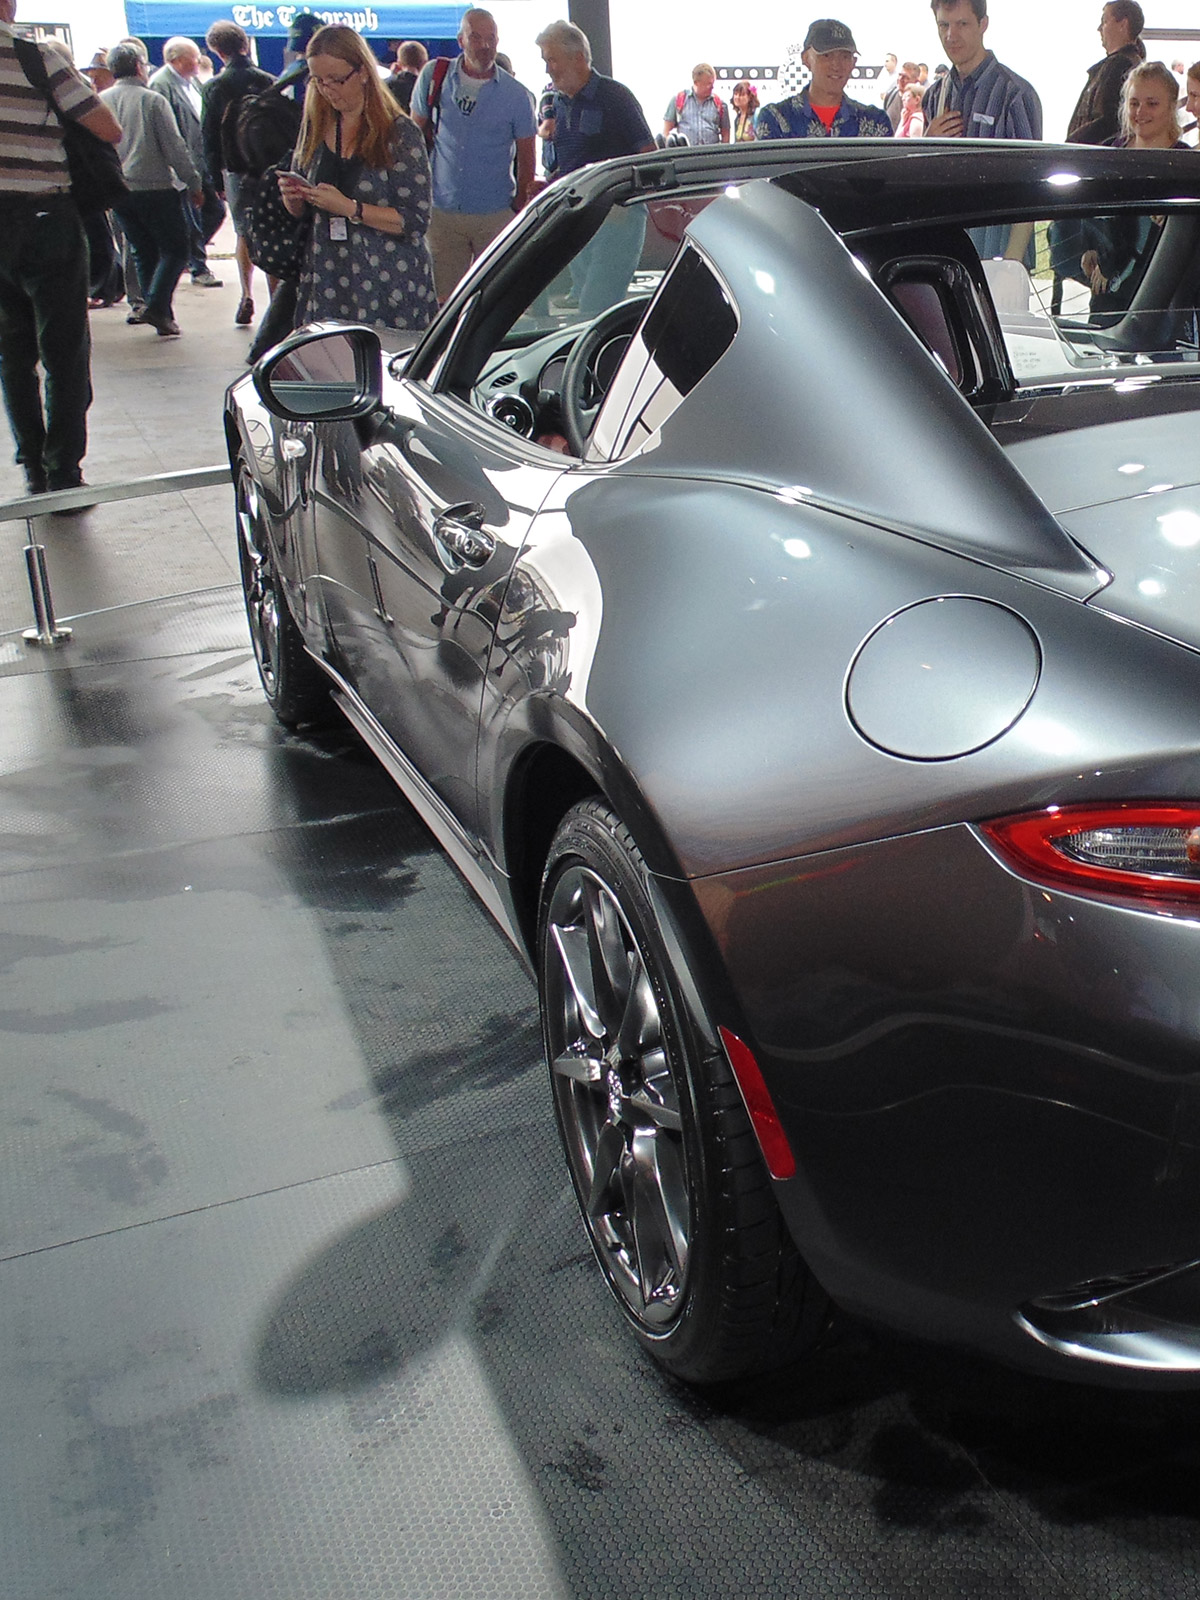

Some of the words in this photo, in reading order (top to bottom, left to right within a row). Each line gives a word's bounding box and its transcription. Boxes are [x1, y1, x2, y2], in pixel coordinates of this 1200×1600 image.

[231, 5, 274, 29] The
[277, 5, 378, 32] Tgraph
[719, 68, 773, 79] GOOD
